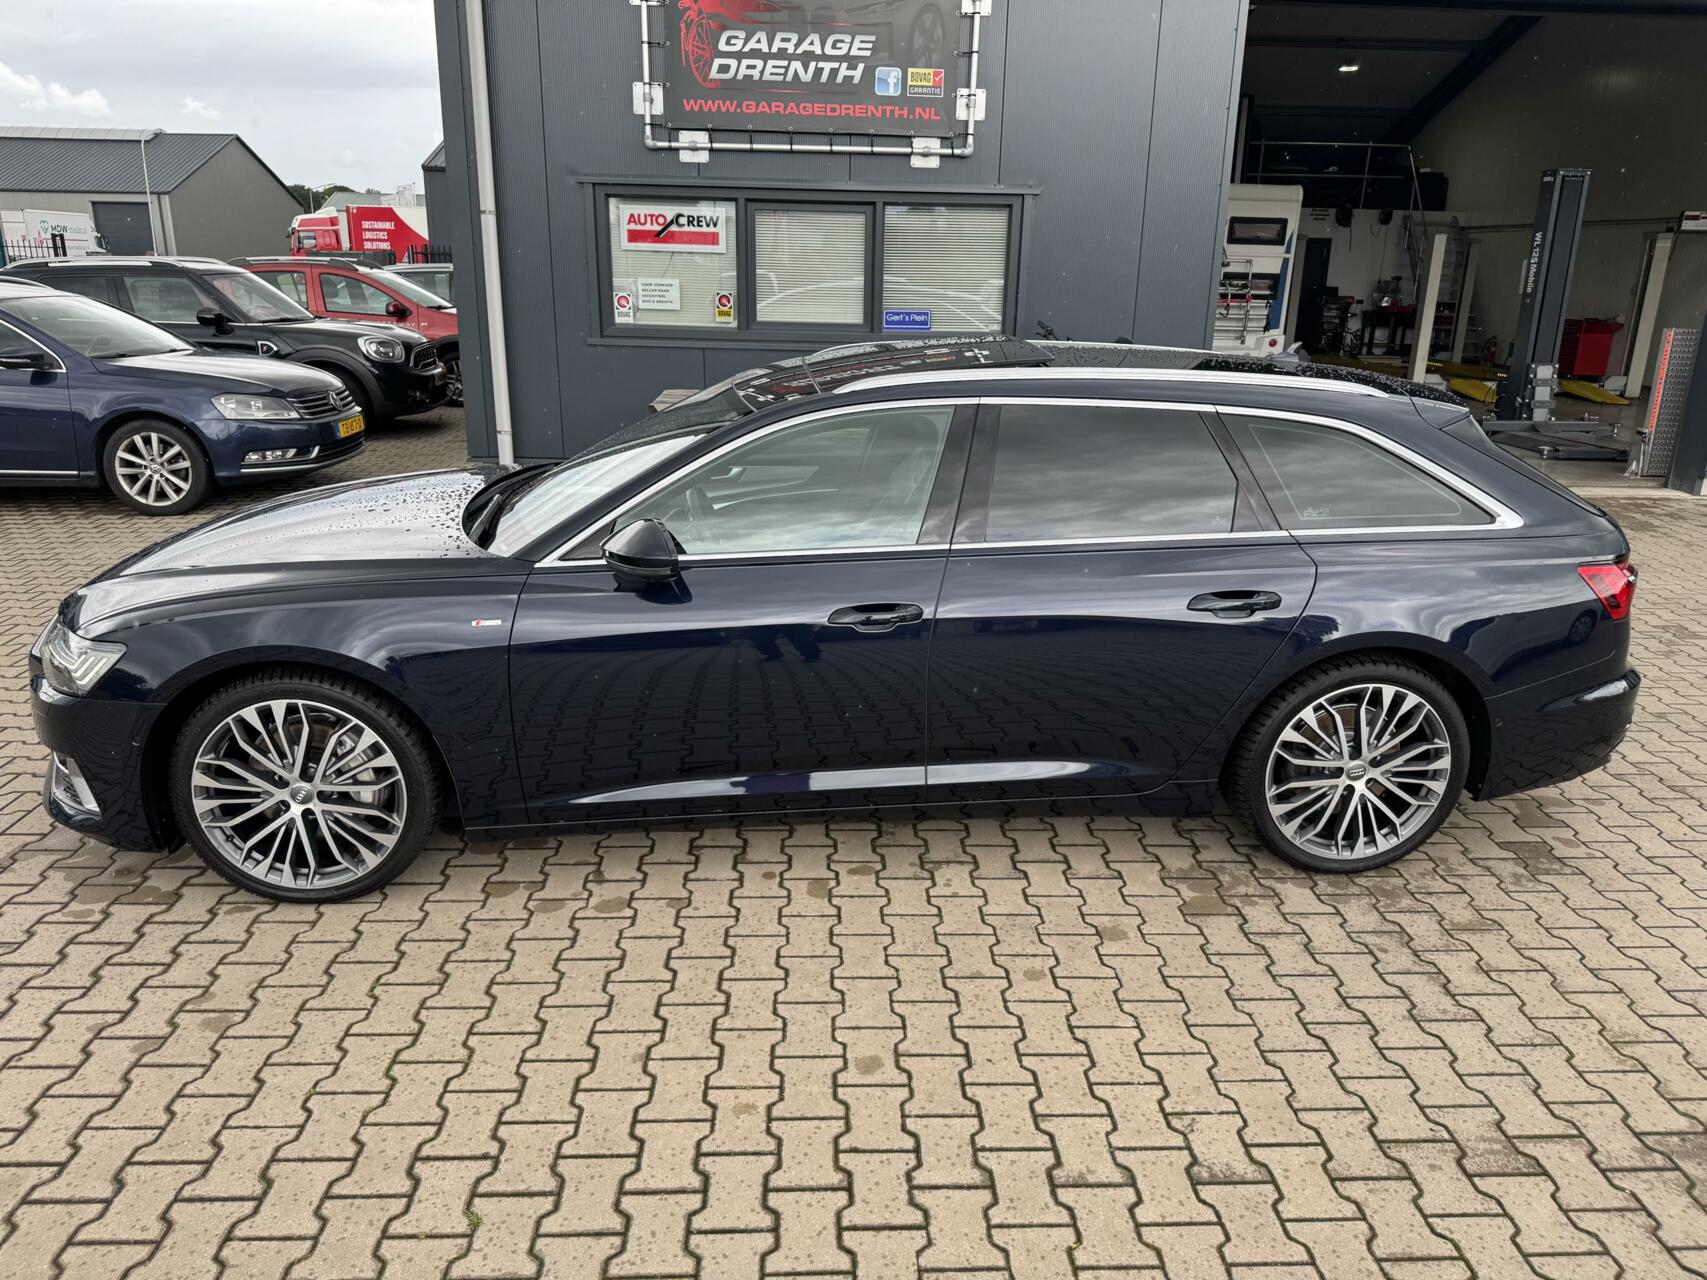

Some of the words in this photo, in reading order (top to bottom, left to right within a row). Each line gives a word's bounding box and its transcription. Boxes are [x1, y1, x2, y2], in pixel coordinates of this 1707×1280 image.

[718, 30, 876, 56] GARAGE
[709, 58, 865, 84] DRENTH
[910, 71, 931, 83] BOVAG
[909, 86, 941, 95] GARANTIE
[683, 99, 941, 119] WWW.GARAGEDRENTH.NL
[361, 220, 395, 230] SUSTAINABLE
[627, 213, 667, 226] AUTO
[675, 213, 720, 228] CREW
[50, 224, 68, 233] MDW
[362, 231, 388, 240] LOGISTICS
[363, 241, 391, 250] SOLUTIONS
[886, 313, 909, 322] Gert's
[910, 313, 928, 322] Plein
